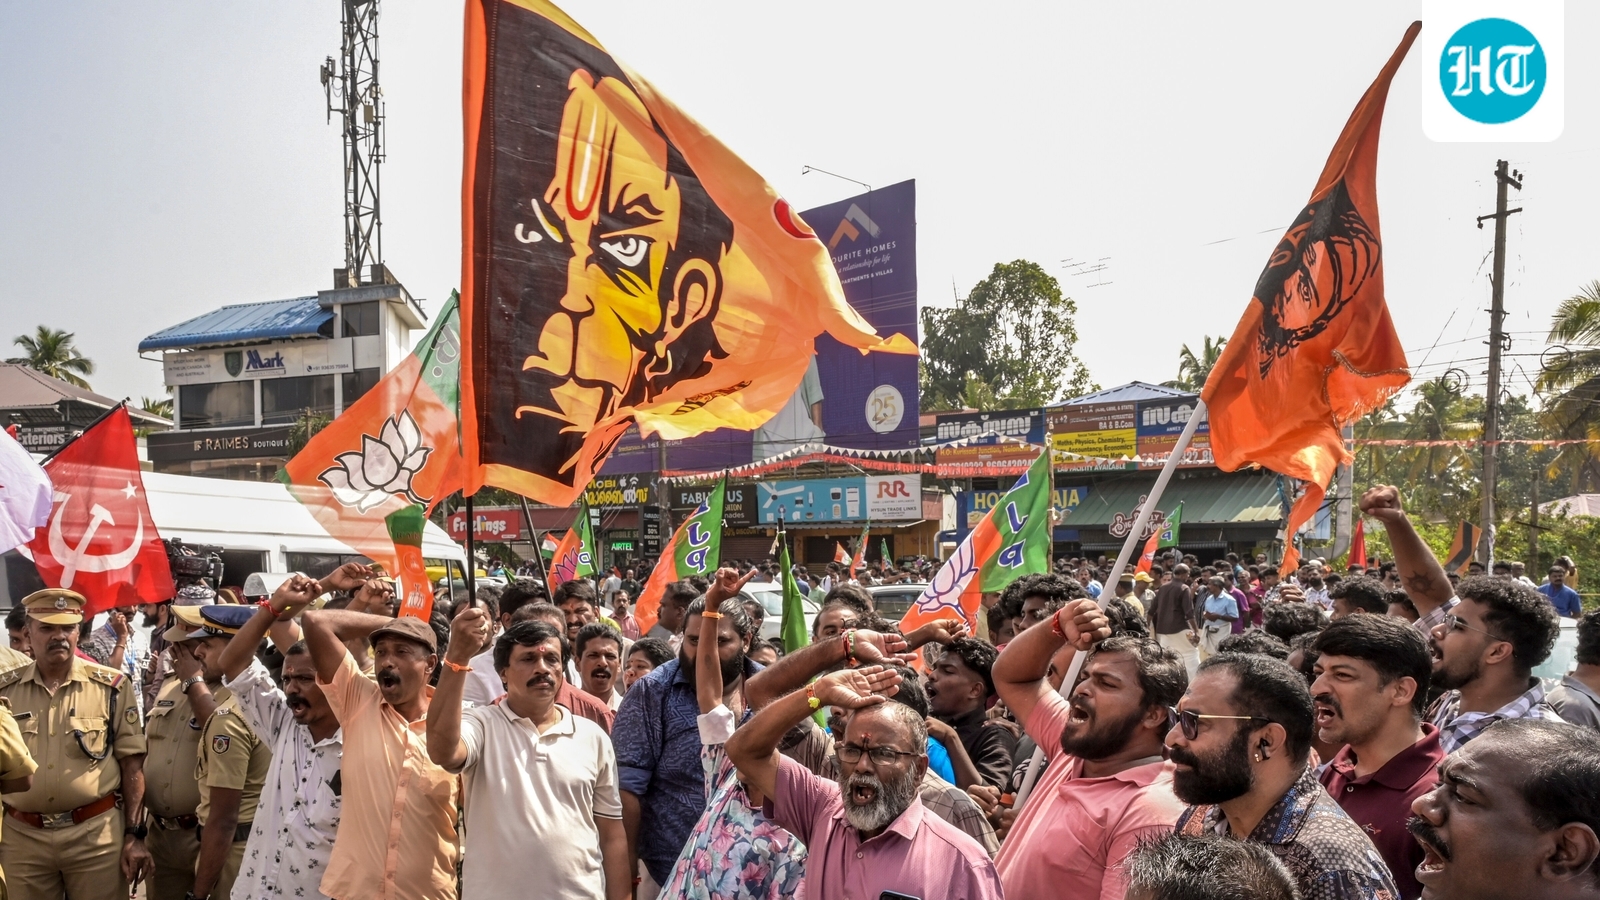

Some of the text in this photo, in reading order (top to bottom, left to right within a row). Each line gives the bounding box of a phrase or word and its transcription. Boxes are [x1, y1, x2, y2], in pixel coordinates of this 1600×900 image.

[832, 241, 896, 264] OURITE HOMES
[843, 258, 872, 271] relationship
[872, 256, 881, 267] for
[882, 253, 891, 264] life
[841, 274, 869, 284] PARTMENTS
[876, 268, 893, 276] VILLAS
[246, 349, 284, 369] Mark
[1060, 415, 1068, 423] +2
[1098, 420, 1134, 430] BA & B.Com
[17, 432, 65, 445] Exteriors
[205, 436, 249, 450] RAIMES
[253, 440, 284, 448] BOUTIQUE
[1074, 438, 1097, 446] Physics,
[1103, 444, 1133, 452] Economics
[1094, 463, 1126, 471] AVAILABLE
[877, 480, 910, 498] RR
[725, 503, 742, 512] SHION
[611, 542, 634, 551] AIRTEL
